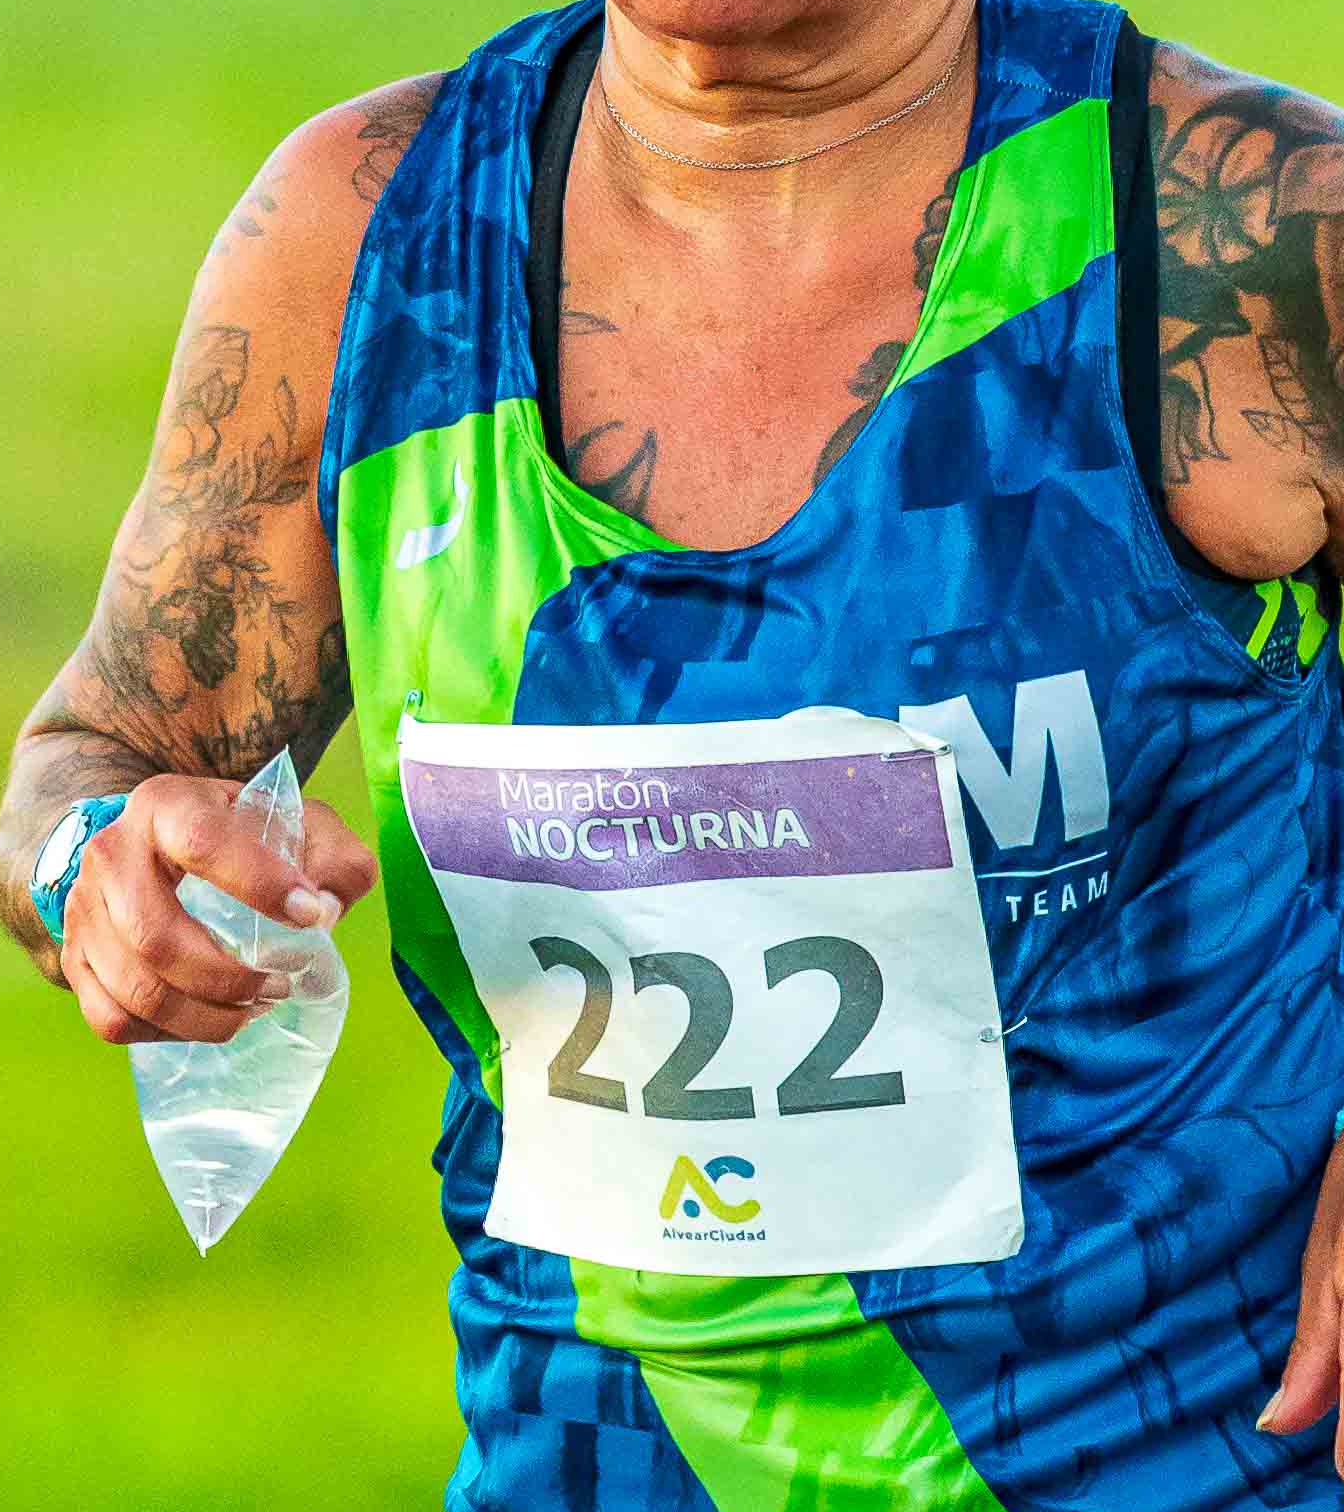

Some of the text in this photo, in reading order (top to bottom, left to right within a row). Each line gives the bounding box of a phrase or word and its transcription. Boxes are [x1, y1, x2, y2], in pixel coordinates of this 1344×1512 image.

[498, 768, 671, 812] Maratón
[506, 807, 810, 862] NOCTURNA
[1006, 871, 1109, 923] TEAM
[528, 936, 906, 1120] 222
